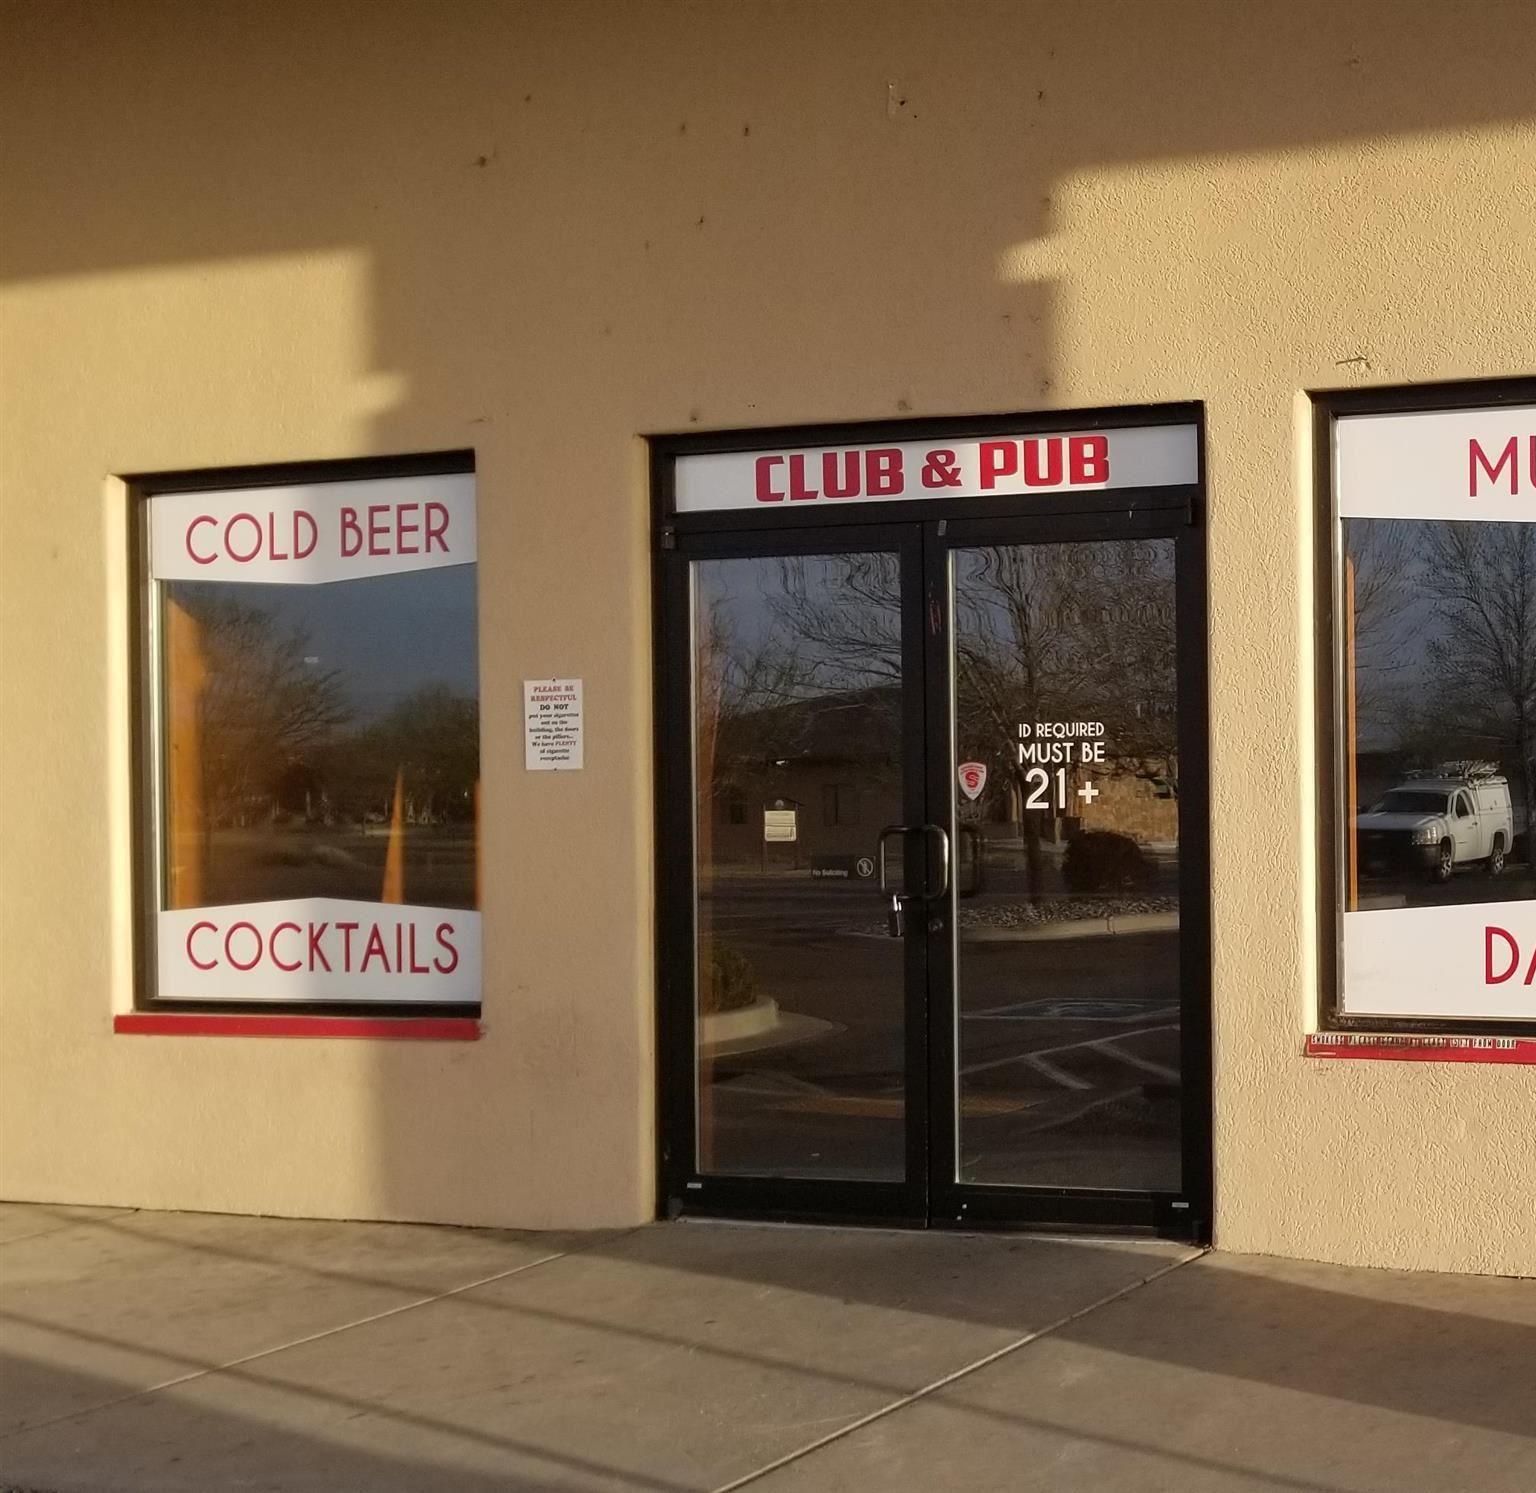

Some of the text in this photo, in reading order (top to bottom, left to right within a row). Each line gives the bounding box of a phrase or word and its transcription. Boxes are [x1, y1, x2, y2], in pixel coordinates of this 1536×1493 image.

[755, 435, 1110, 502] CLUB & PUB
[185, 501, 450, 565] COLD BEER
[531, 694, 577, 702] RESPECTFUL
[554, 703, 569, 711] NOT
[1018, 722, 1105, 739] ID REQUIRED
[1018, 741, 1106, 764] MUST BE
[1025, 767, 1099, 810] 21+
[185, 920, 458, 974] COCKTAILS
[1472, 1038, 1493, 1048] FROM
